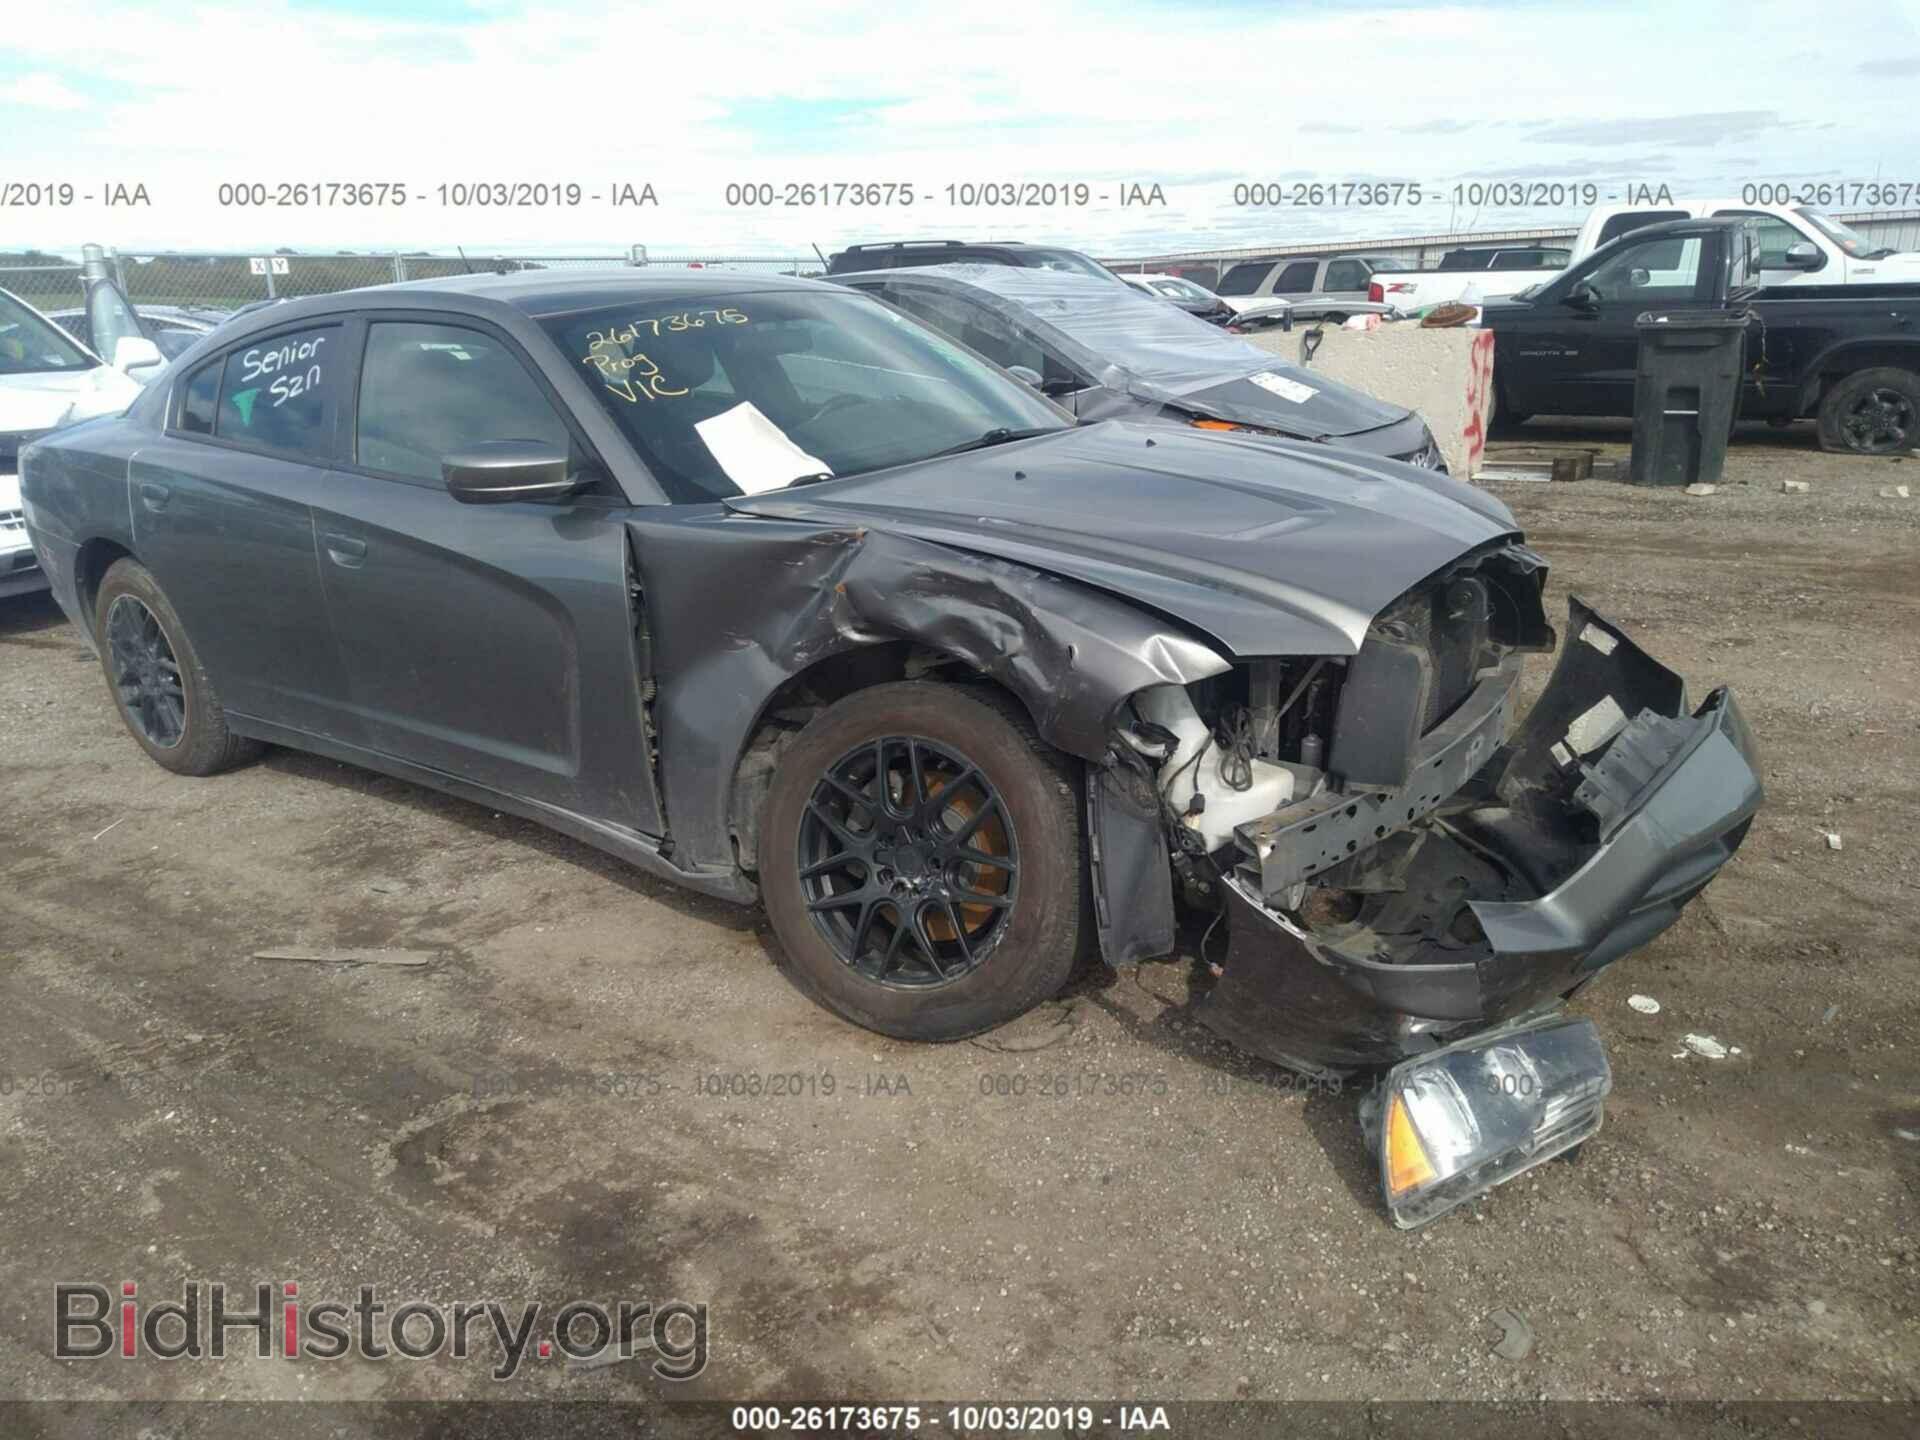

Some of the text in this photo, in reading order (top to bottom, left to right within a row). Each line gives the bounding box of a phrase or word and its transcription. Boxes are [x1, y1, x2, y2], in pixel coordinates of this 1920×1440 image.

[586, 309, 749, 349] 26173675
[241, 337, 325, 382] Senior
[605, 375, 689, 402] VIC
